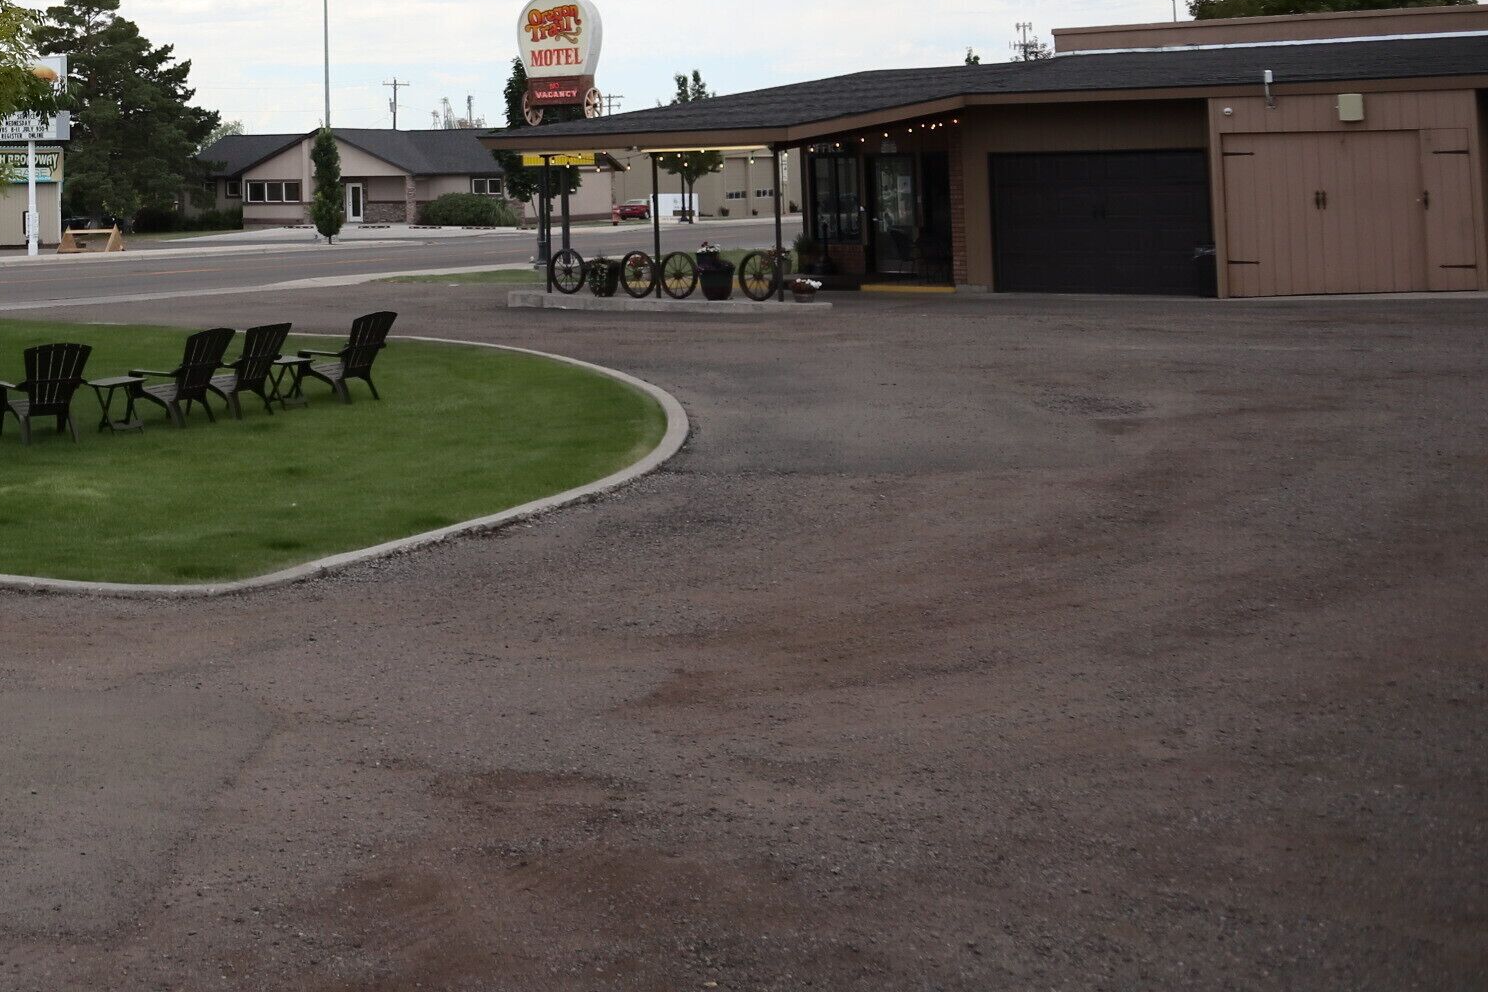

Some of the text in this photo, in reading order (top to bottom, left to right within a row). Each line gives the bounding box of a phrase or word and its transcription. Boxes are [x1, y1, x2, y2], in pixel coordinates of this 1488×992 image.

[528, 5, 581, 28] Oregon
[525, 17, 572, 42] Trail
[531, 48, 583, 66] MOTEL
[535, 90, 578, 99] VACANCY
